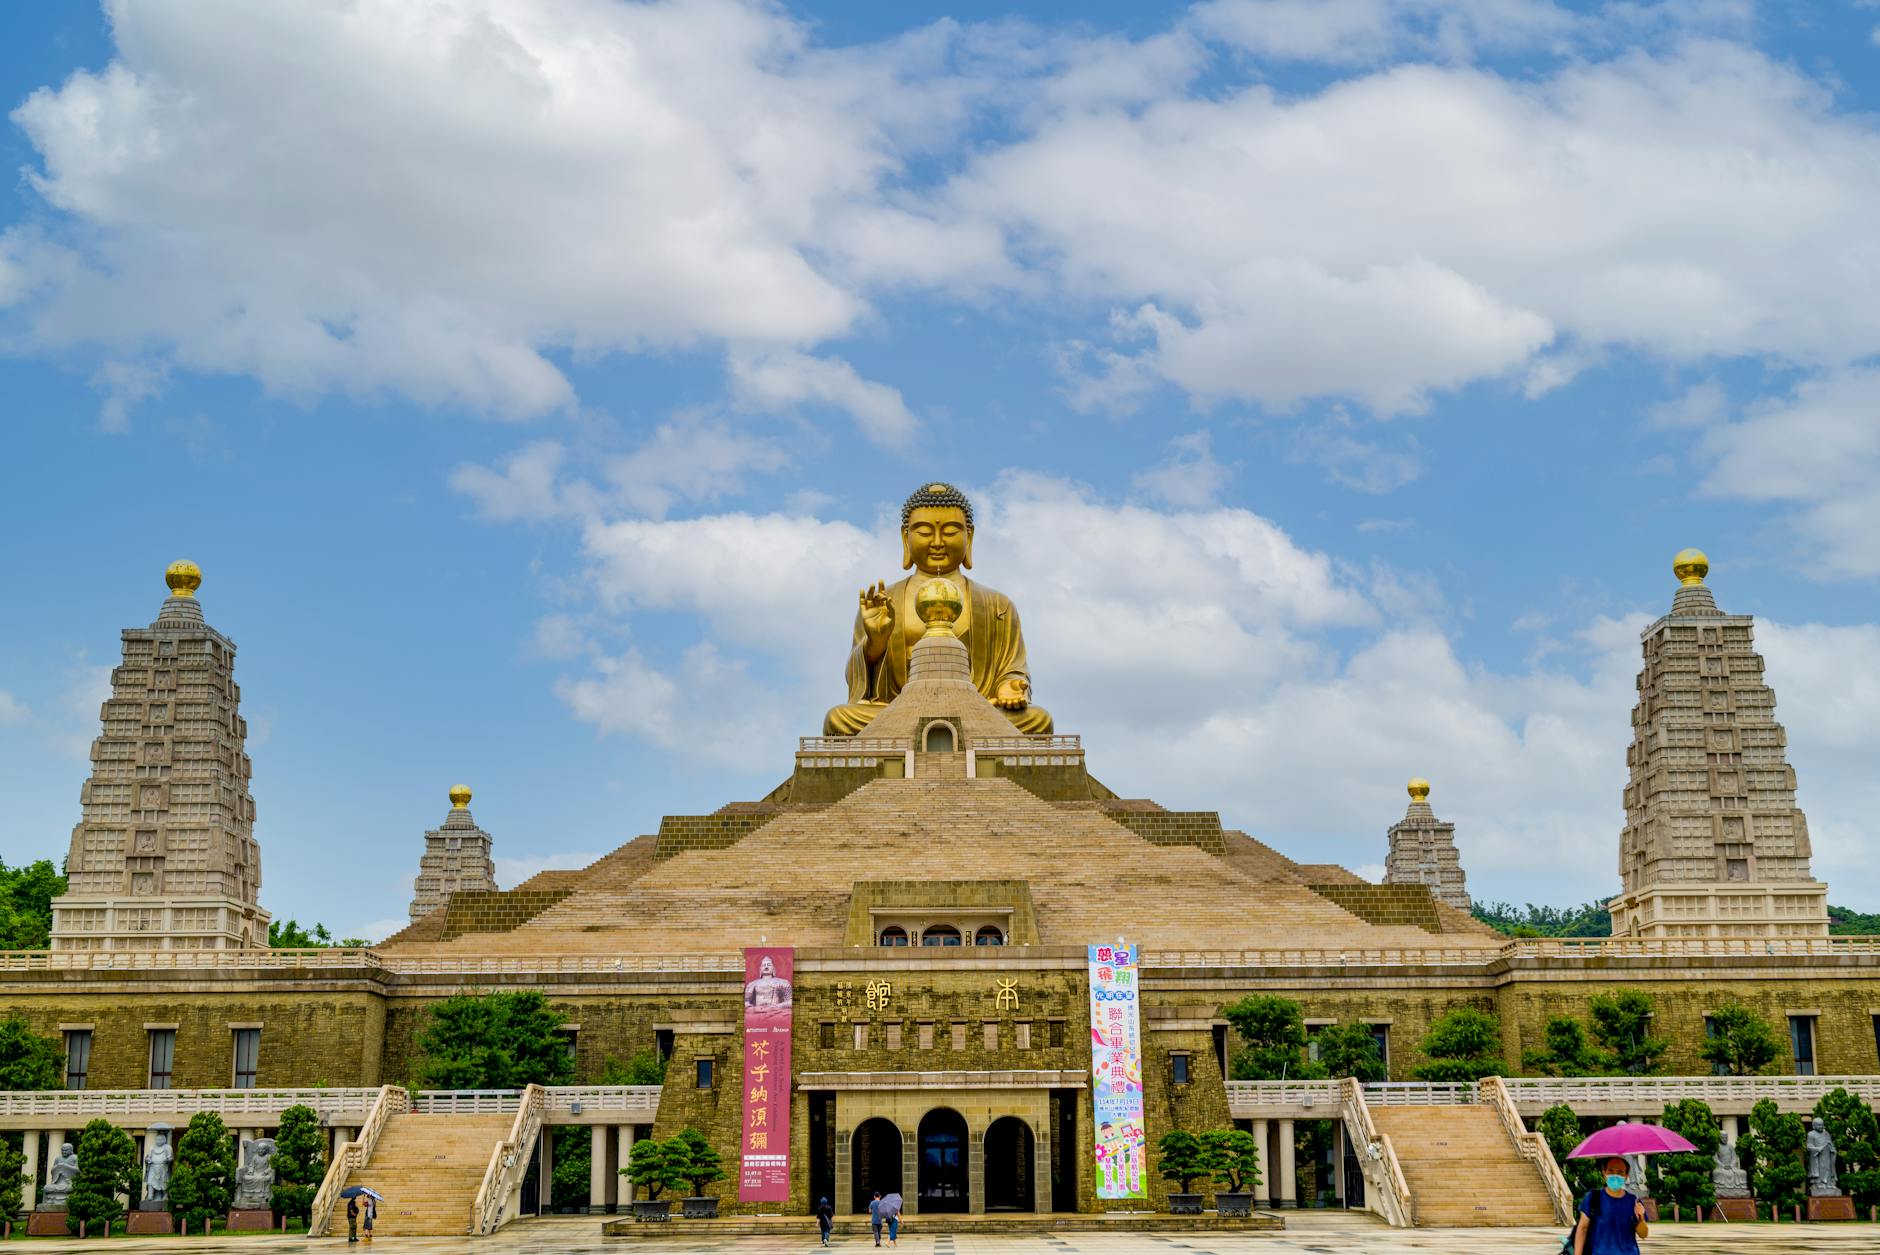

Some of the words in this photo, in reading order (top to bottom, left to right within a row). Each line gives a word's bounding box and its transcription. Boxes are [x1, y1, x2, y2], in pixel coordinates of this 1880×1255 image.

[1097, 947, 1130, 966] 慈星
[1097, 966, 1131, 985] 飛翔
[1108, 1007, 1125, 1094] 聯合畢業典禮
